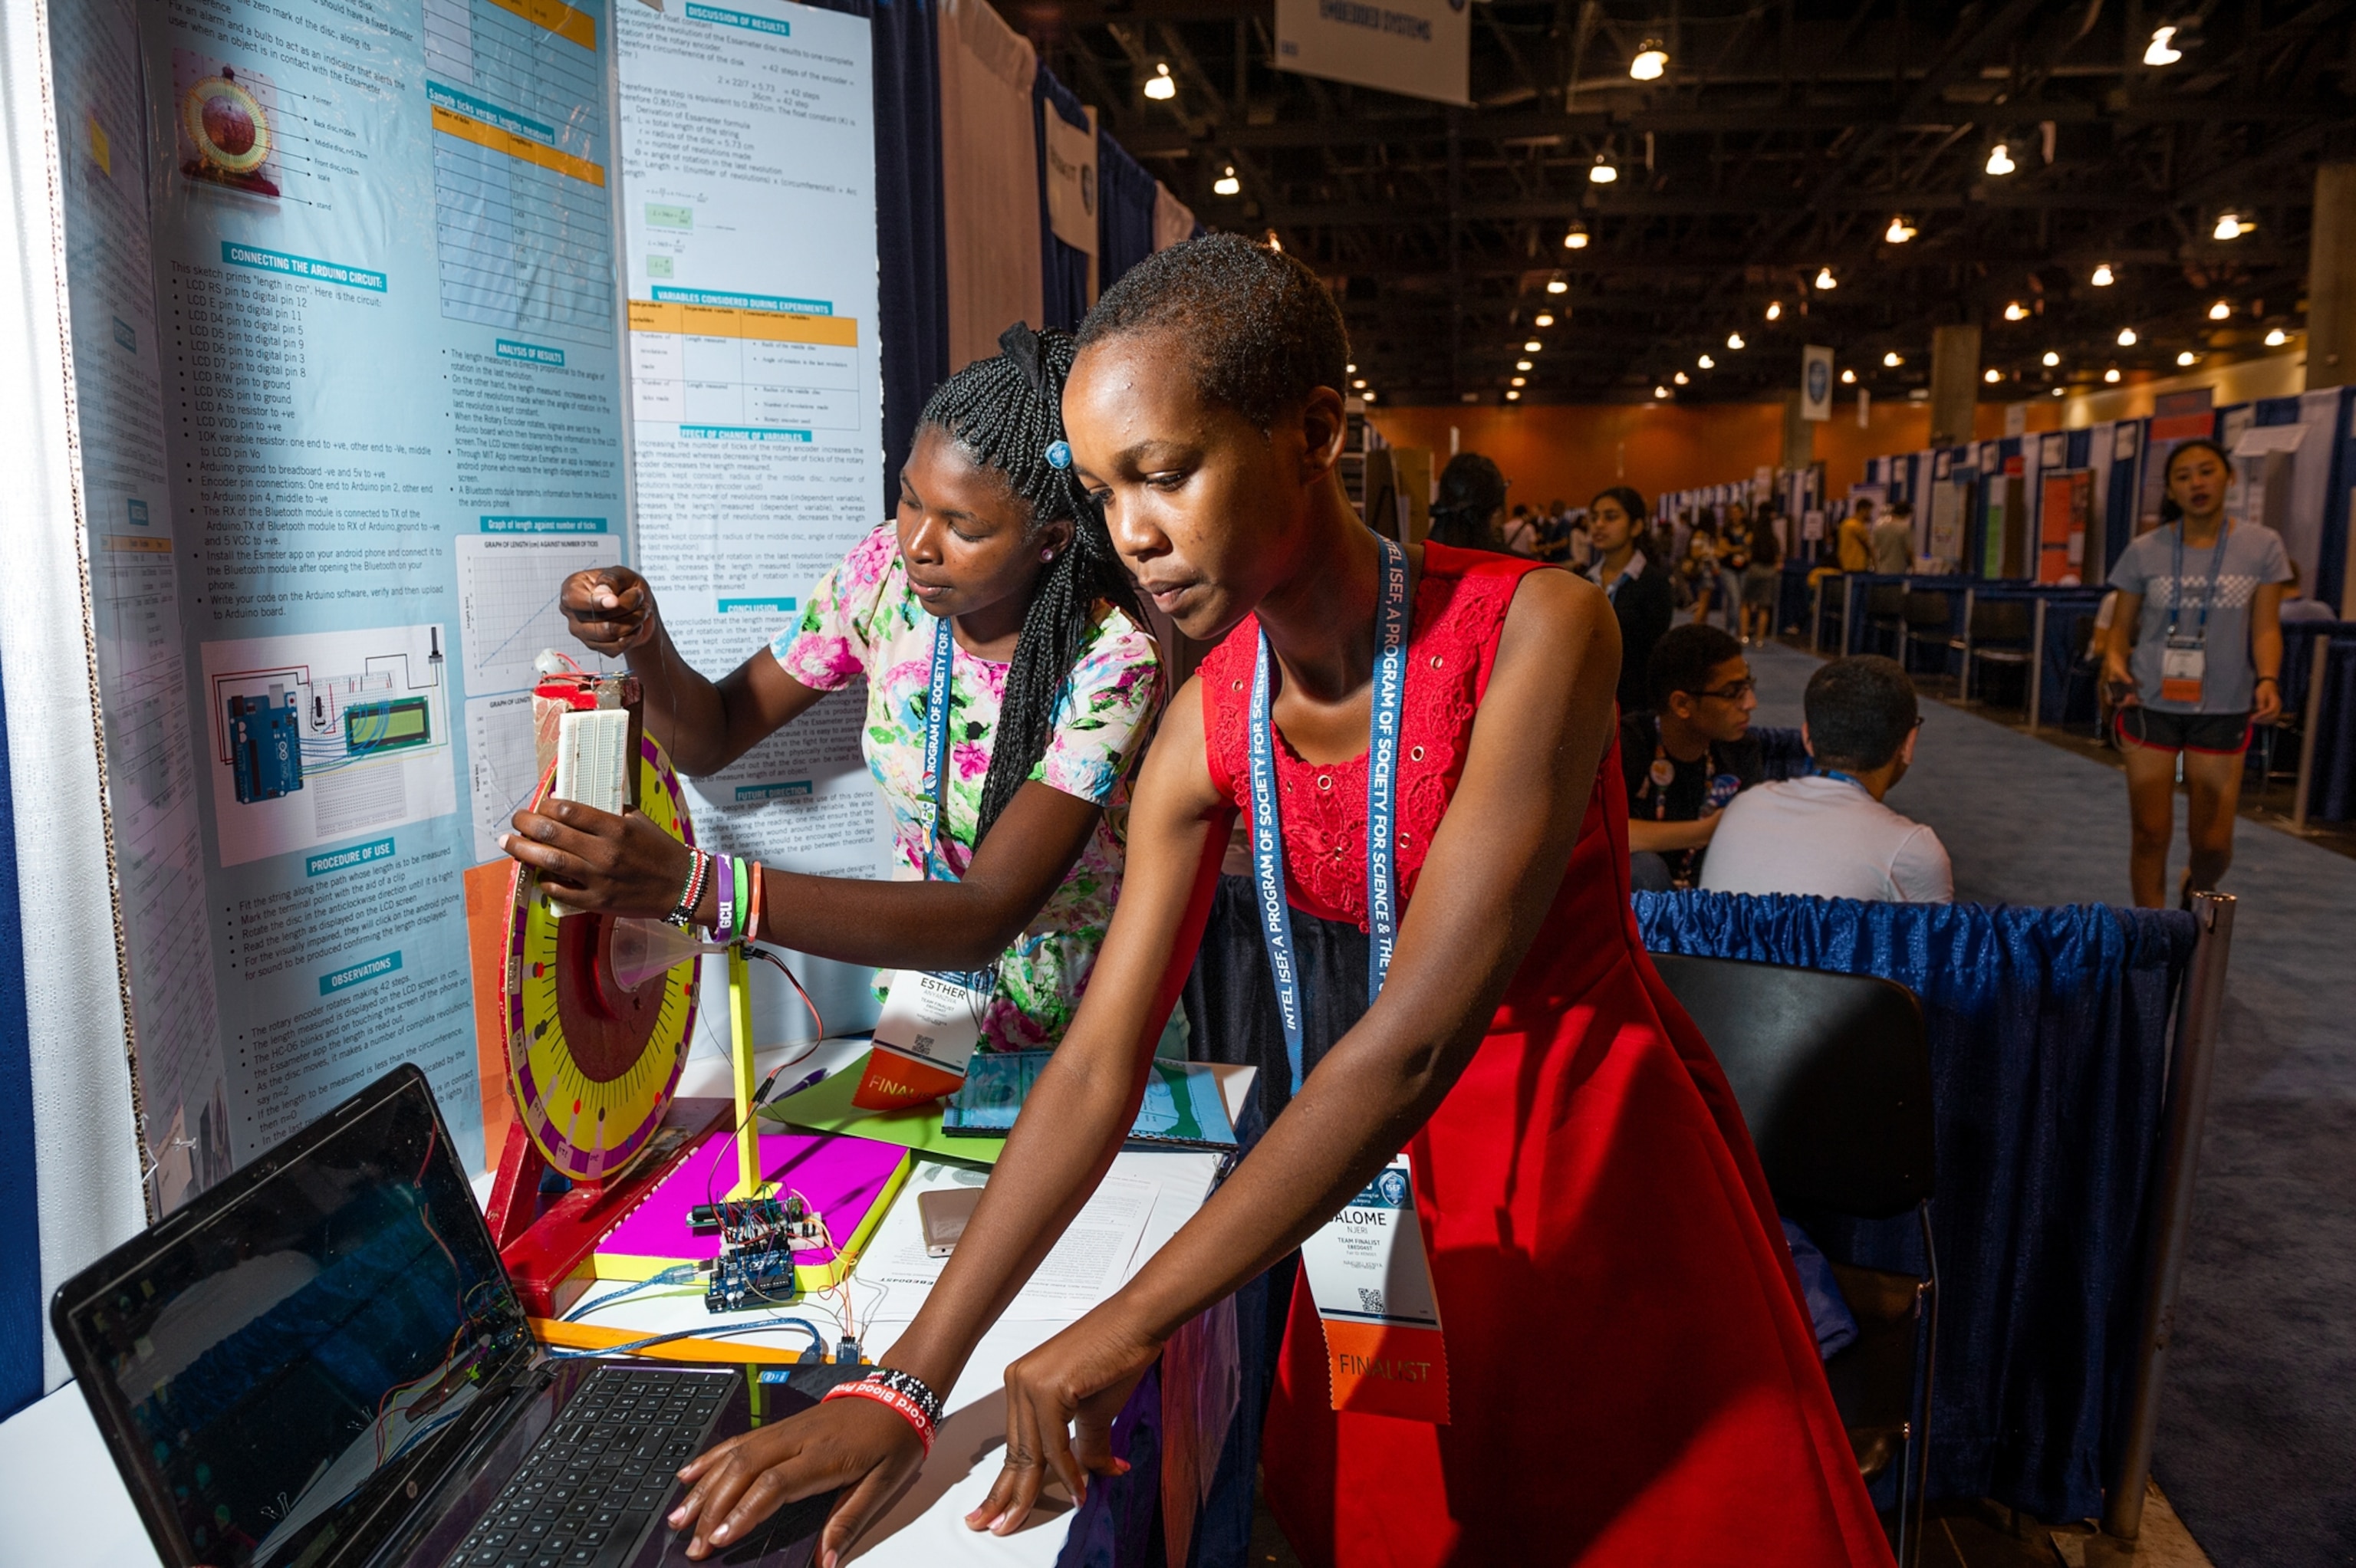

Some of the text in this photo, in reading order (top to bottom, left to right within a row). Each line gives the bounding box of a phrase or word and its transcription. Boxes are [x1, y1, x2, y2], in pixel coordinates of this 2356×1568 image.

[689, 6, 786, 33] DISCUSSION OF RESULTS
[429, 88, 552, 143] Sample ticks versus lengths measured
[232, 248, 382, 288] CONNECTING THE ARDUINO CIRCUIT:
[186, 280, 307, 307] LCD RS pin to digital pin 12
[657, 291, 828, 314] VARIABLES CONSIDERED DURING EXPERIMENTS
[499, 344, 562, 363] ANALYSIS OF RESULTS
[638, 440, 675, 449] Increasing
[708, 429, 716, 439] OF
[719, 431, 749, 440] CHANGE
[752, 432, 760, 440] OF
[763, 432, 803, 442] VARIABLES
[489, 520, 506, 531] Graph
[515, 521, 532, 531] length
[535, 521, 554, 531] against
[210, 595, 232, 604] Write
[235, 596, 252, 606] your
[257, 593, 275, 602] code
[291, 592, 303, 600] the
[306, 590, 334, 600] Arduino
[337, 590, 368, 598] software,
[371, 588, 389, 598] verify
[405, 587, 419, 595] then
[422, 585, 443, 596] upload
[1386, 567, 1403, 603] ISEF,
[728, 604, 778, 613] CONCLUSION
[1388, 607, 1400, 620] A
[938, 634, 948, 657] FOR
[1380, 624, 1400, 707] PROGRAM
[932, 659, 946, 705] SOCIETY
[931, 706, 941, 723] OF
[1378, 712, 1393, 735] OF
[926, 725, 940, 772] ROGRAM
[1374, 738, 1391, 810] SOCIETY
[738, 787, 807, 800] FUTURE DIRECTION
[727, 812, 758, 820] assemble,
[764, 807, 803, 817] user-friendly
[1253, 658, 1295, 1030] INTEL ISEF, A PROGRAM OF SOCIETY FOR SCIENCE
[1373, 815, 1387, 848] FOR
[312, 843, 390, 872] PROCEDURE OF USE
[240, 900, 252, 911] Fit
[255, 897, 266, 907] the
[268, 892, 291, 903] string
[293, 886, 314, 896] along
[316, 881, 328, 891] the
[331, 875, 347, 889] path
[350, 871, 370, 882] whose
[373, 862, 393, 875] length
[422, 847, 451, 862] measured
[1374, 850, 1388, 920] SCIENCE
[241, 912, 261, 925] Mark
[264, 909, 276, 919] the
[279, 898, 311, 915] terminal
[314, 892, 332, 907] point
[335, 886, 350, 898] with
[353, 884, 363, 893] the
[366, 879, 376, 889] aid
[379, 877, 385, 886] of
[393, 874, 405, 883] clip
[1377, 922, 1390, 933] &
[1379, 937, 1392, 967] THE
[331, 958, 391, 986] OBSERVATIONS
[920, 978, 966, 1000] ESTHER
[252, 977, 410, 1037] The rotary encoder rotates making 42 steps.
[934, 1002, 954, 1011] FINALIST
[1334, 1211, 1387, 1225] ALOME
[1340, 1354, 1431, 1383] FINALIST
[857, 1386, 896, 1402] Blood
[896, 1399, 925, 1428] Cord
